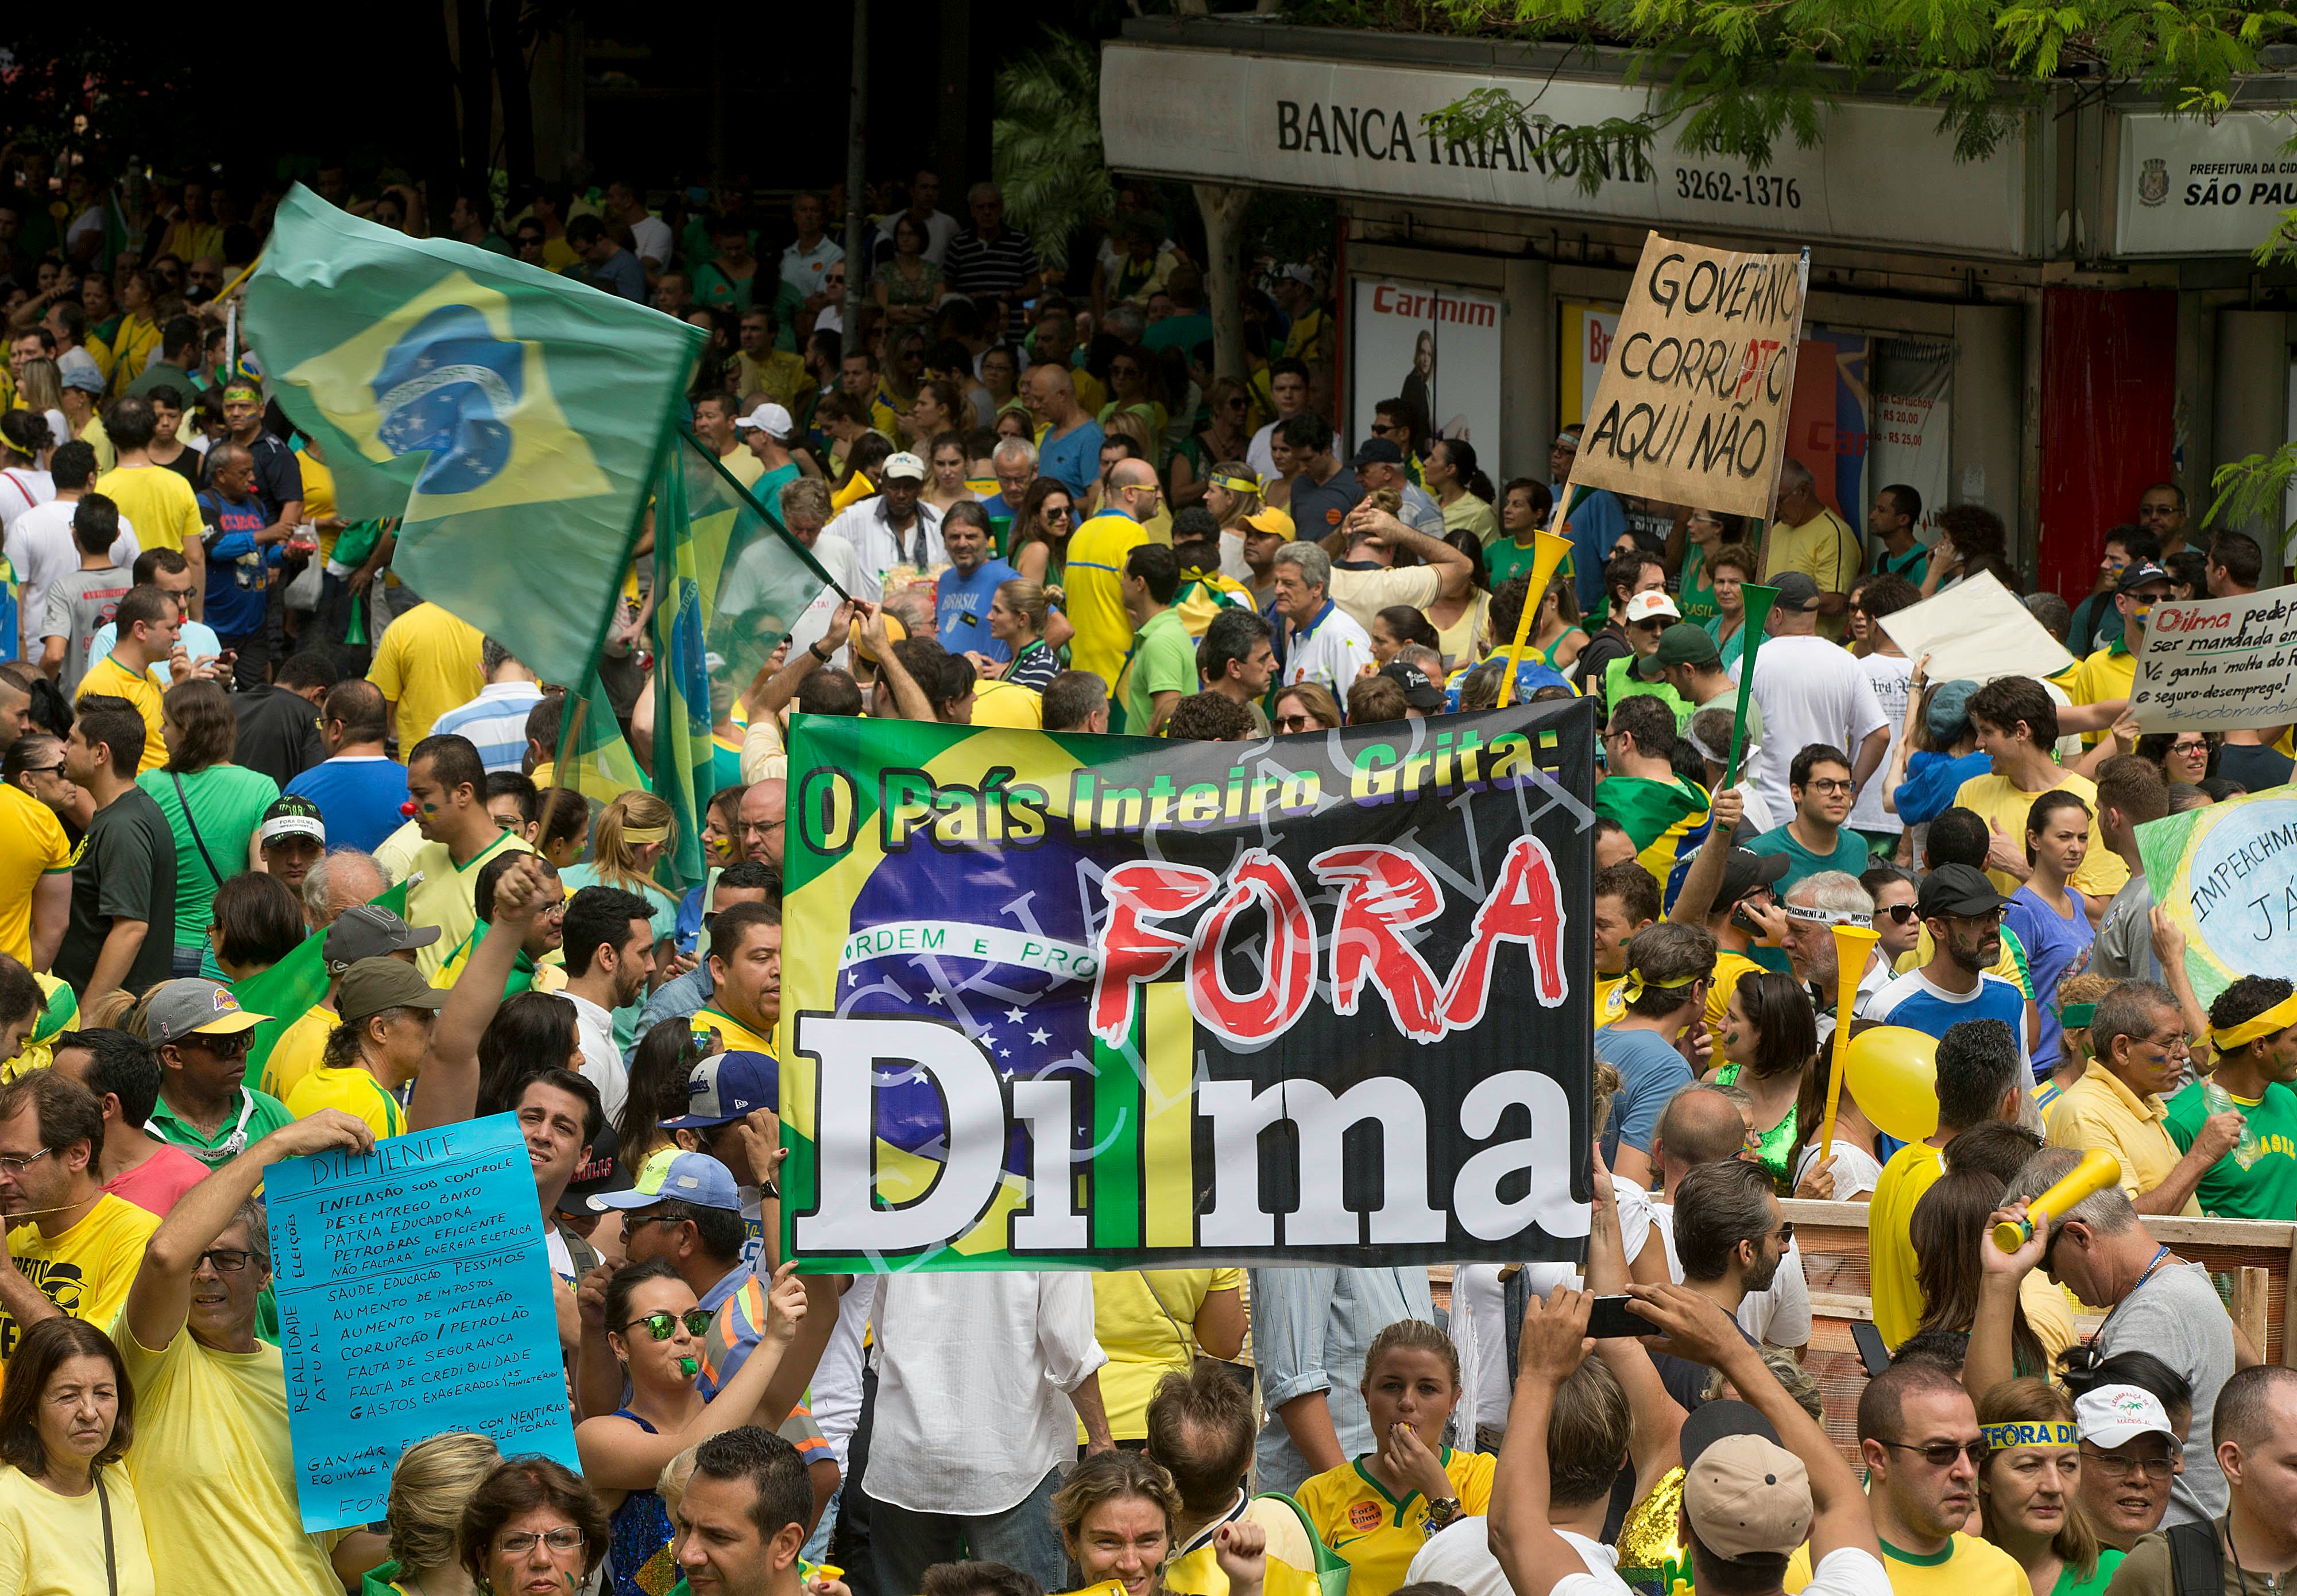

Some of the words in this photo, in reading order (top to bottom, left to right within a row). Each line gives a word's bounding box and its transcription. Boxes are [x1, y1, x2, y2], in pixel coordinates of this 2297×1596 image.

[1277, 100, 1416, 163] BANCA
[1676, 168, 1801, 209] 3262-1376
[2190, 163, 2258, 175] PREFEITURA
[2261, 162, 2275, 174] DA
[2183, 177, 2242, 206] SÃO
[2249, 182, 2297, 205] PAU
[1373, 285, 1495, 328] Carmim
[1620, 331, 1788, 405] CORRUPTO
[1896, 411, 1919, 425] 20,00
[1587, 400, 1693, 471] AQUI
[1687, 397, 1767, 480] NÃO
[1901, 432, 1922, 447] 25,00
[941, 593, 980, 611] BRASIL
[1684, 602, 1716, 618] RASIL
[2156, 607, 2232, 633] Dilma
[2149, 639, 2183, 653] ser
[2187, 625, 2273, 651] mandada
[2167, 661, 2217, 687] ganha
[2267, 651, 2285, 669] do
[2136, 691, 2151, 704] e
[799, 766, 859, 856] O
[879, 765, 1050, 855] País
[1069, 765, 1322, 839] Inteiro
[1351, 729, 1561, 808] Grita:
[2190, 821, 2297, 923] IMPEACHM
[1818, 910, 1827, 920] JÁ
[845, 927, 946, 961] ORDEM
[973, 938, 988, 955] E
[1089, 834, 1570, 1049] FORA
[2243, 1134, 2296, 1168] ASIL
[316, 1181, 404, 1215] INFLAÇÃO
[412, 1180, 438, 1192] SOB
[444, 1157, 514, 1184] CONTROLE
[323, 1226, 382, 1250] PATRIA
[390, 1206, 473, 1234] EDUCADORA
[325, 1200, 431, 1230] DESEMPREGO
[439, 1186, 482, 1204] BAIXO
[270, 1225, 283, 1280] ANTES
[331, 1264, 357, 1279] NÃO
[481, 1223, 532, 1245] ELETRICA
[333, 1236, 421, 1264] PETROBRAS
[434, 1213, 507, 1240] EFICIENTE
[383, 1269, 442, 1291] EDUCAÇÃO
[333, 1297, 407, 1322] AUMENTO
[417, 1291, 433, 1303] DE
[340, 1315, 415, 1341] AUMENTO
[424, 1310, 442, 1321] DE
[446, 1291, 513, 1315] INFLAÇÃO
[340, 1330, 429, 1361] CORRUPÇÃO
[450, 1306, 530, 1334] PETROLÃO
[309, 1322, 327, 1402] ATUAL
[346, 1361, 390, 1380] FALTA
[397, 1356, 416, 1369] DE
[424, 1332, 514, 1362] SEGURANÇA
[349, 1380, 394, 1400] FALTA
[400, 1377, 415, 1388] DE
[350, 1398, 417, 1420] GASTOS
[423, 1380, 500, 1404] EXAGERADOS
[307, 1446, 386, 1472] GANHAR
[479, 1419, 503, 1431] COM
[510, 1403, 566, 1425] MENTIRAS
[312, 1465, 376, 1486] EQUIVALE
[381, 1462, 390, 1471] A
[1351, 1505, 1375, 1516] Fora
[1351, 1511, 1381, 1525] Dilma
